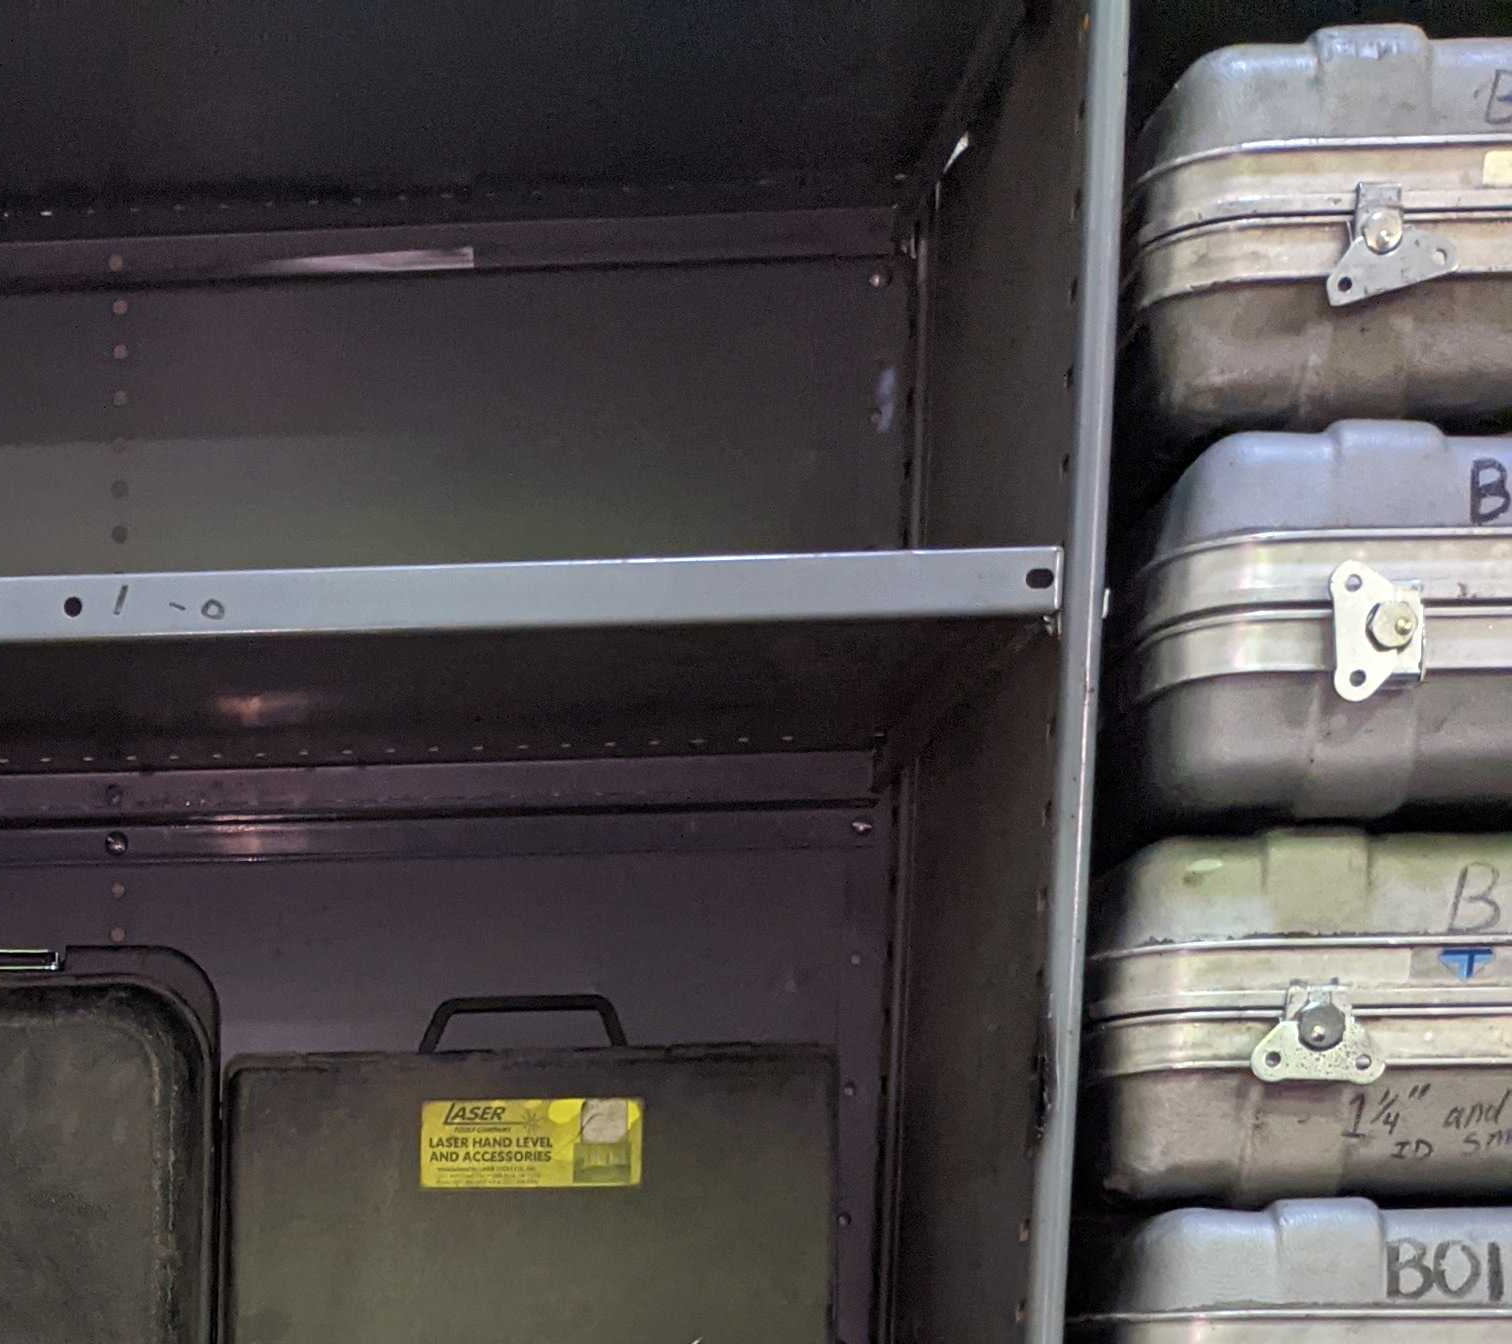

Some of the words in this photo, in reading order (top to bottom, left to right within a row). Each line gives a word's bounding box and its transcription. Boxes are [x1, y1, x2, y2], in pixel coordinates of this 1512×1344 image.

[1470, 458, 1510, 526] B
[1448, 862, 1501, 934] B
[443, 1102, 506, 1125] LASER
[429, 1137, 469, 1149] LASER
[472, 1137, 513, 1148] HAND
[515, 1137, 553, 1148] LEVEL
[429, 1151, 459, 1162] AND
[462, 1150, 552, 1162] ACCESSORIES
